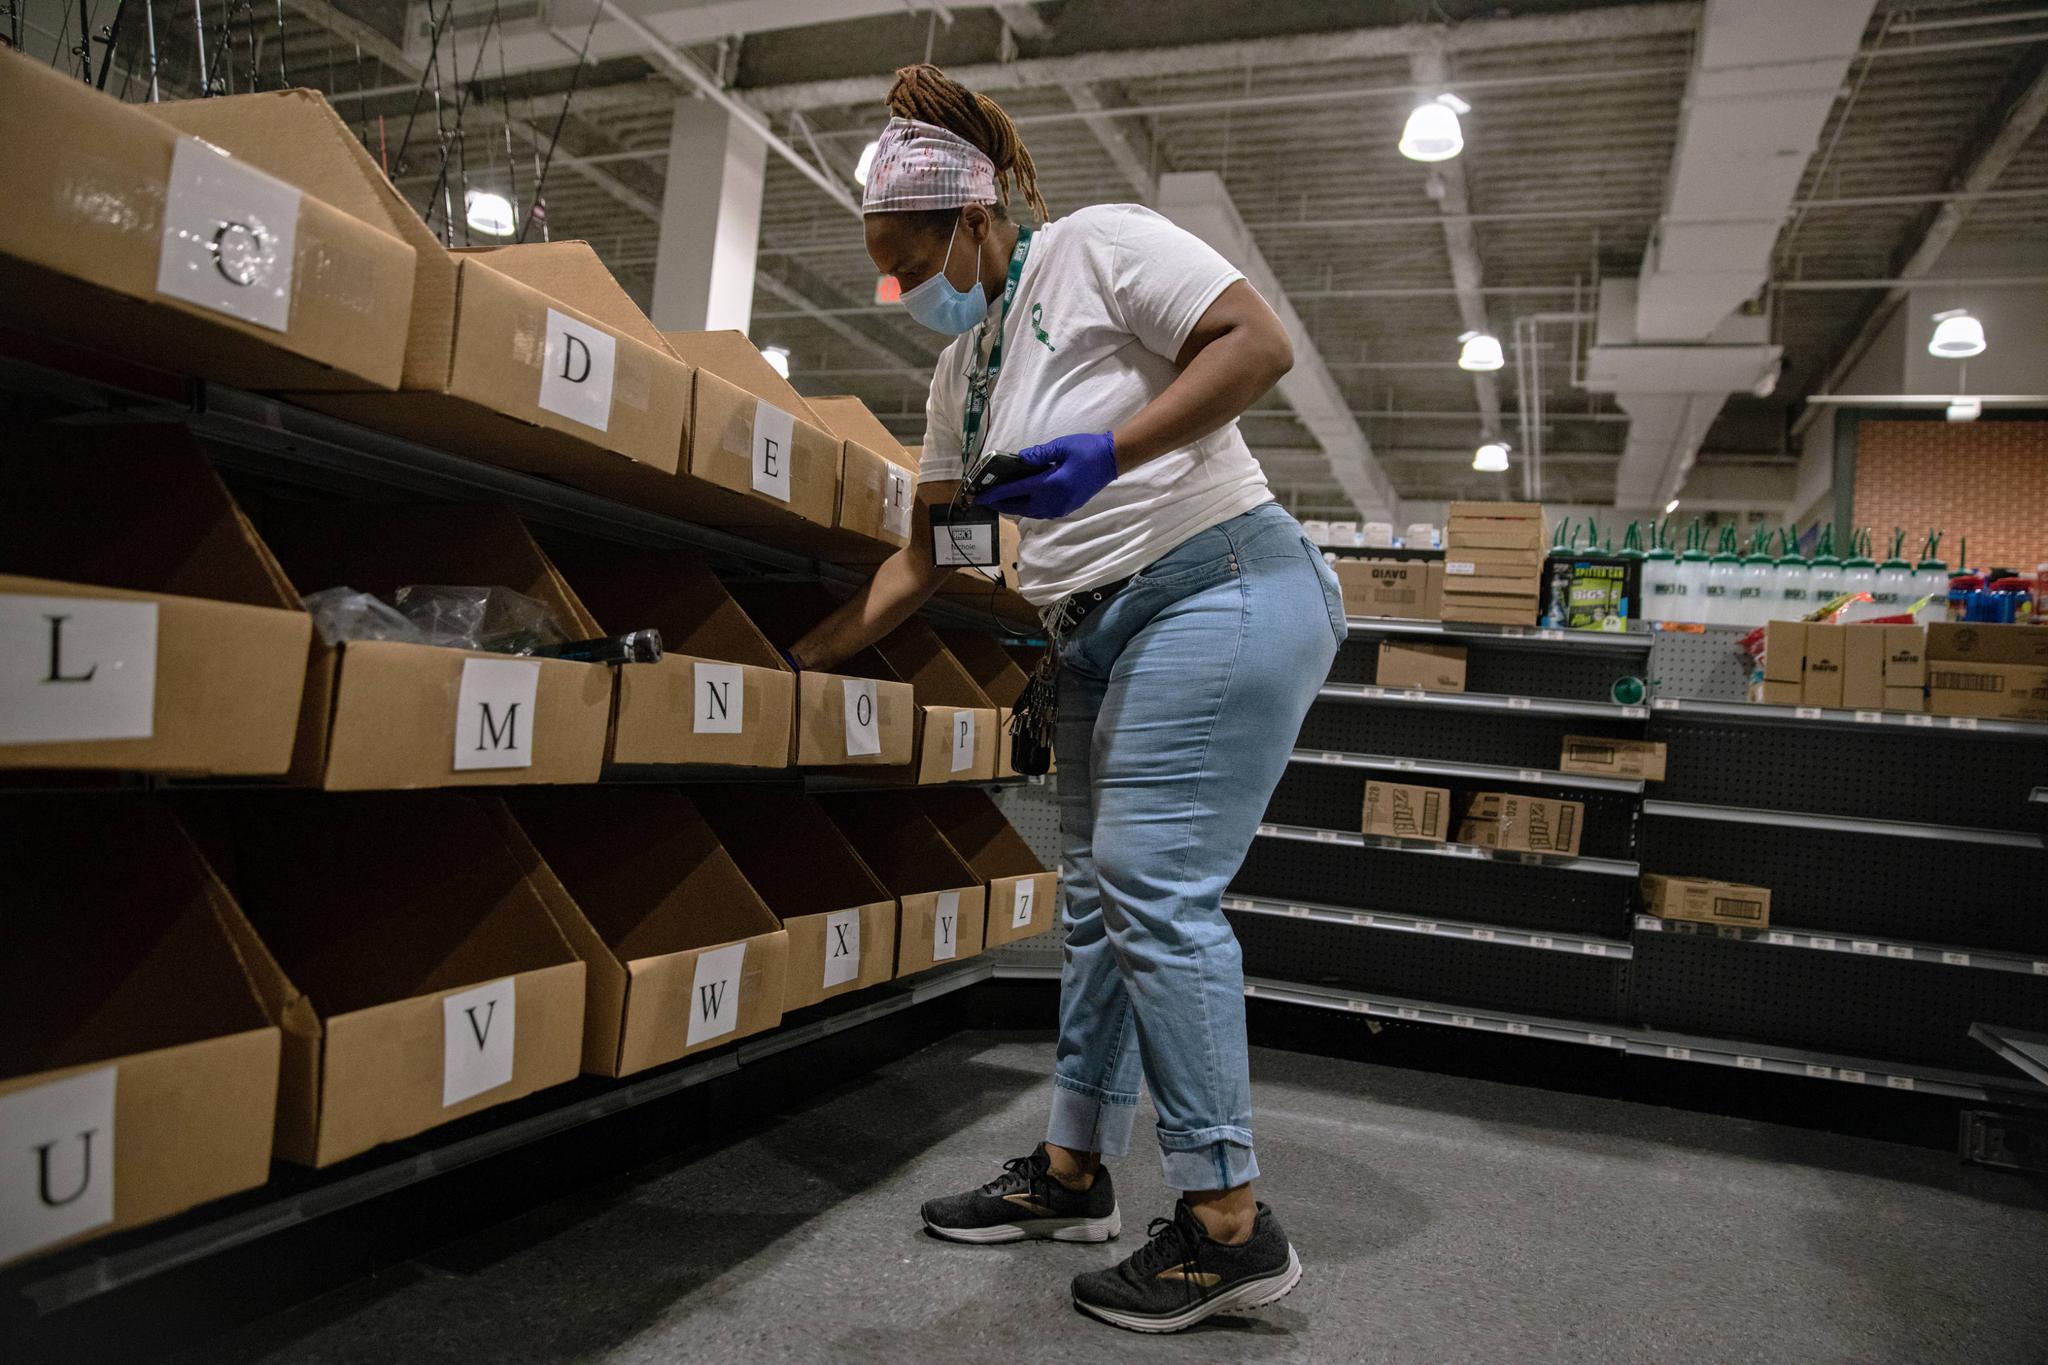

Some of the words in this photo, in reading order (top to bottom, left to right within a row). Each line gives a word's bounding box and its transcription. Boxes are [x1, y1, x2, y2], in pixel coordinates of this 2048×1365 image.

[212, 221, 261, 287] C
[560, 333, 592, 383] D
[762, 437, 779, 478] E
[894, 477, 904, 507] F
[1372, 568, 1407, 579] DAVID
[44, 614, 97, 683] L
[706, 681, 729, 720] N
[857, 694, 872, 727] O
[475, 702, 520, 750] M
[959, 720, 968, 749] P
[1506, 800, 1517, 817] 028
[1020, 895, 1029, 919] Z
[833, 923, 849, 958] X
[941, 915, 953, 944] Y
[700, 979, 727, 1023] W
[464, 1000, 497, 1052] V
[34, 1129, 99, 1208] U
